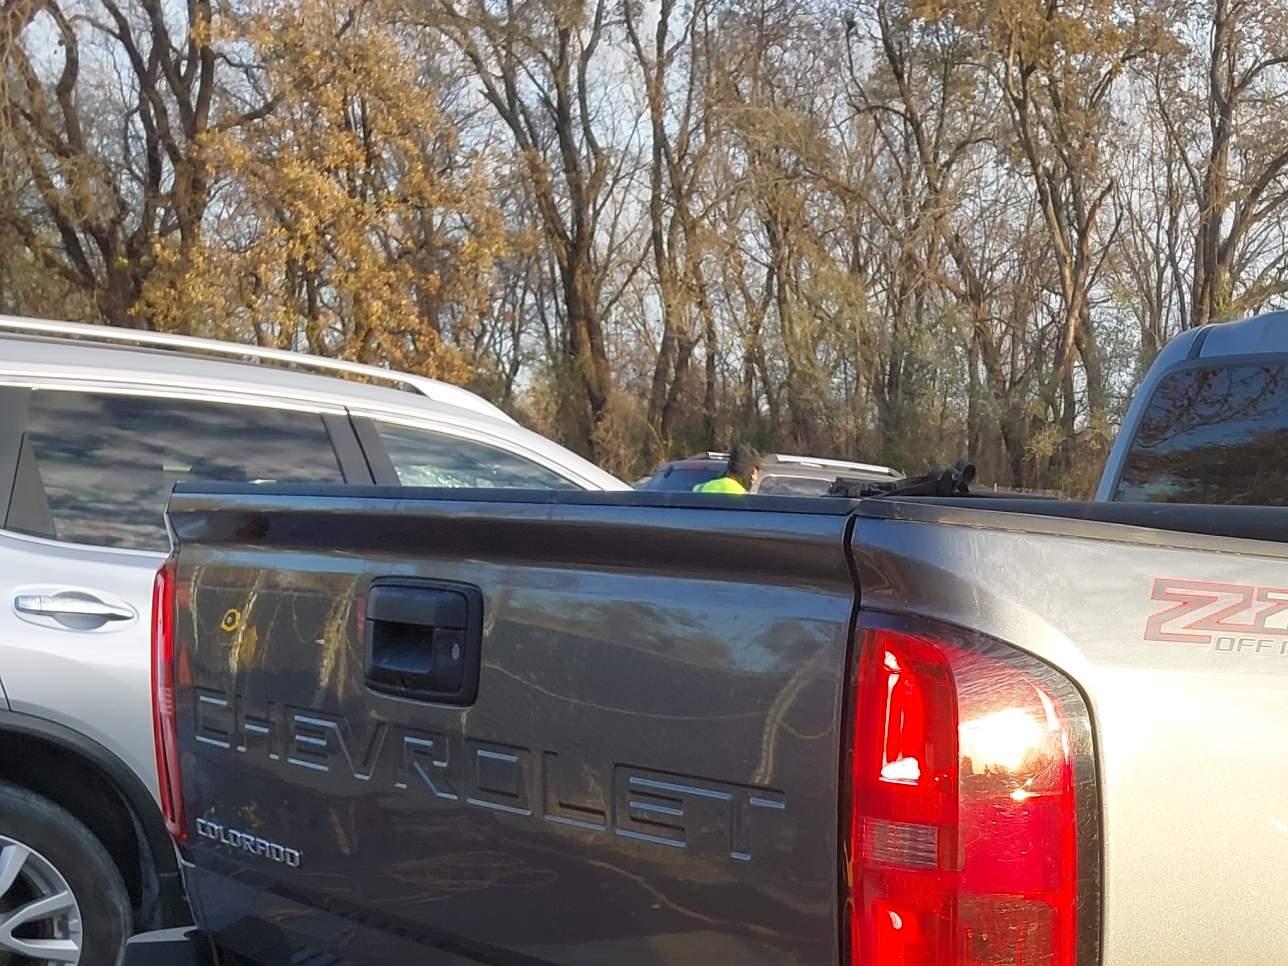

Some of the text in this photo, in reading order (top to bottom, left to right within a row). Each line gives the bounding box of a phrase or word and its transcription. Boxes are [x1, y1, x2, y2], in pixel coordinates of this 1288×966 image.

[1215, 636, 1273, 653] OFF
[192, 686, 787, 861] CHEVROLET
[196, 818, 300, 867] COLORADO
